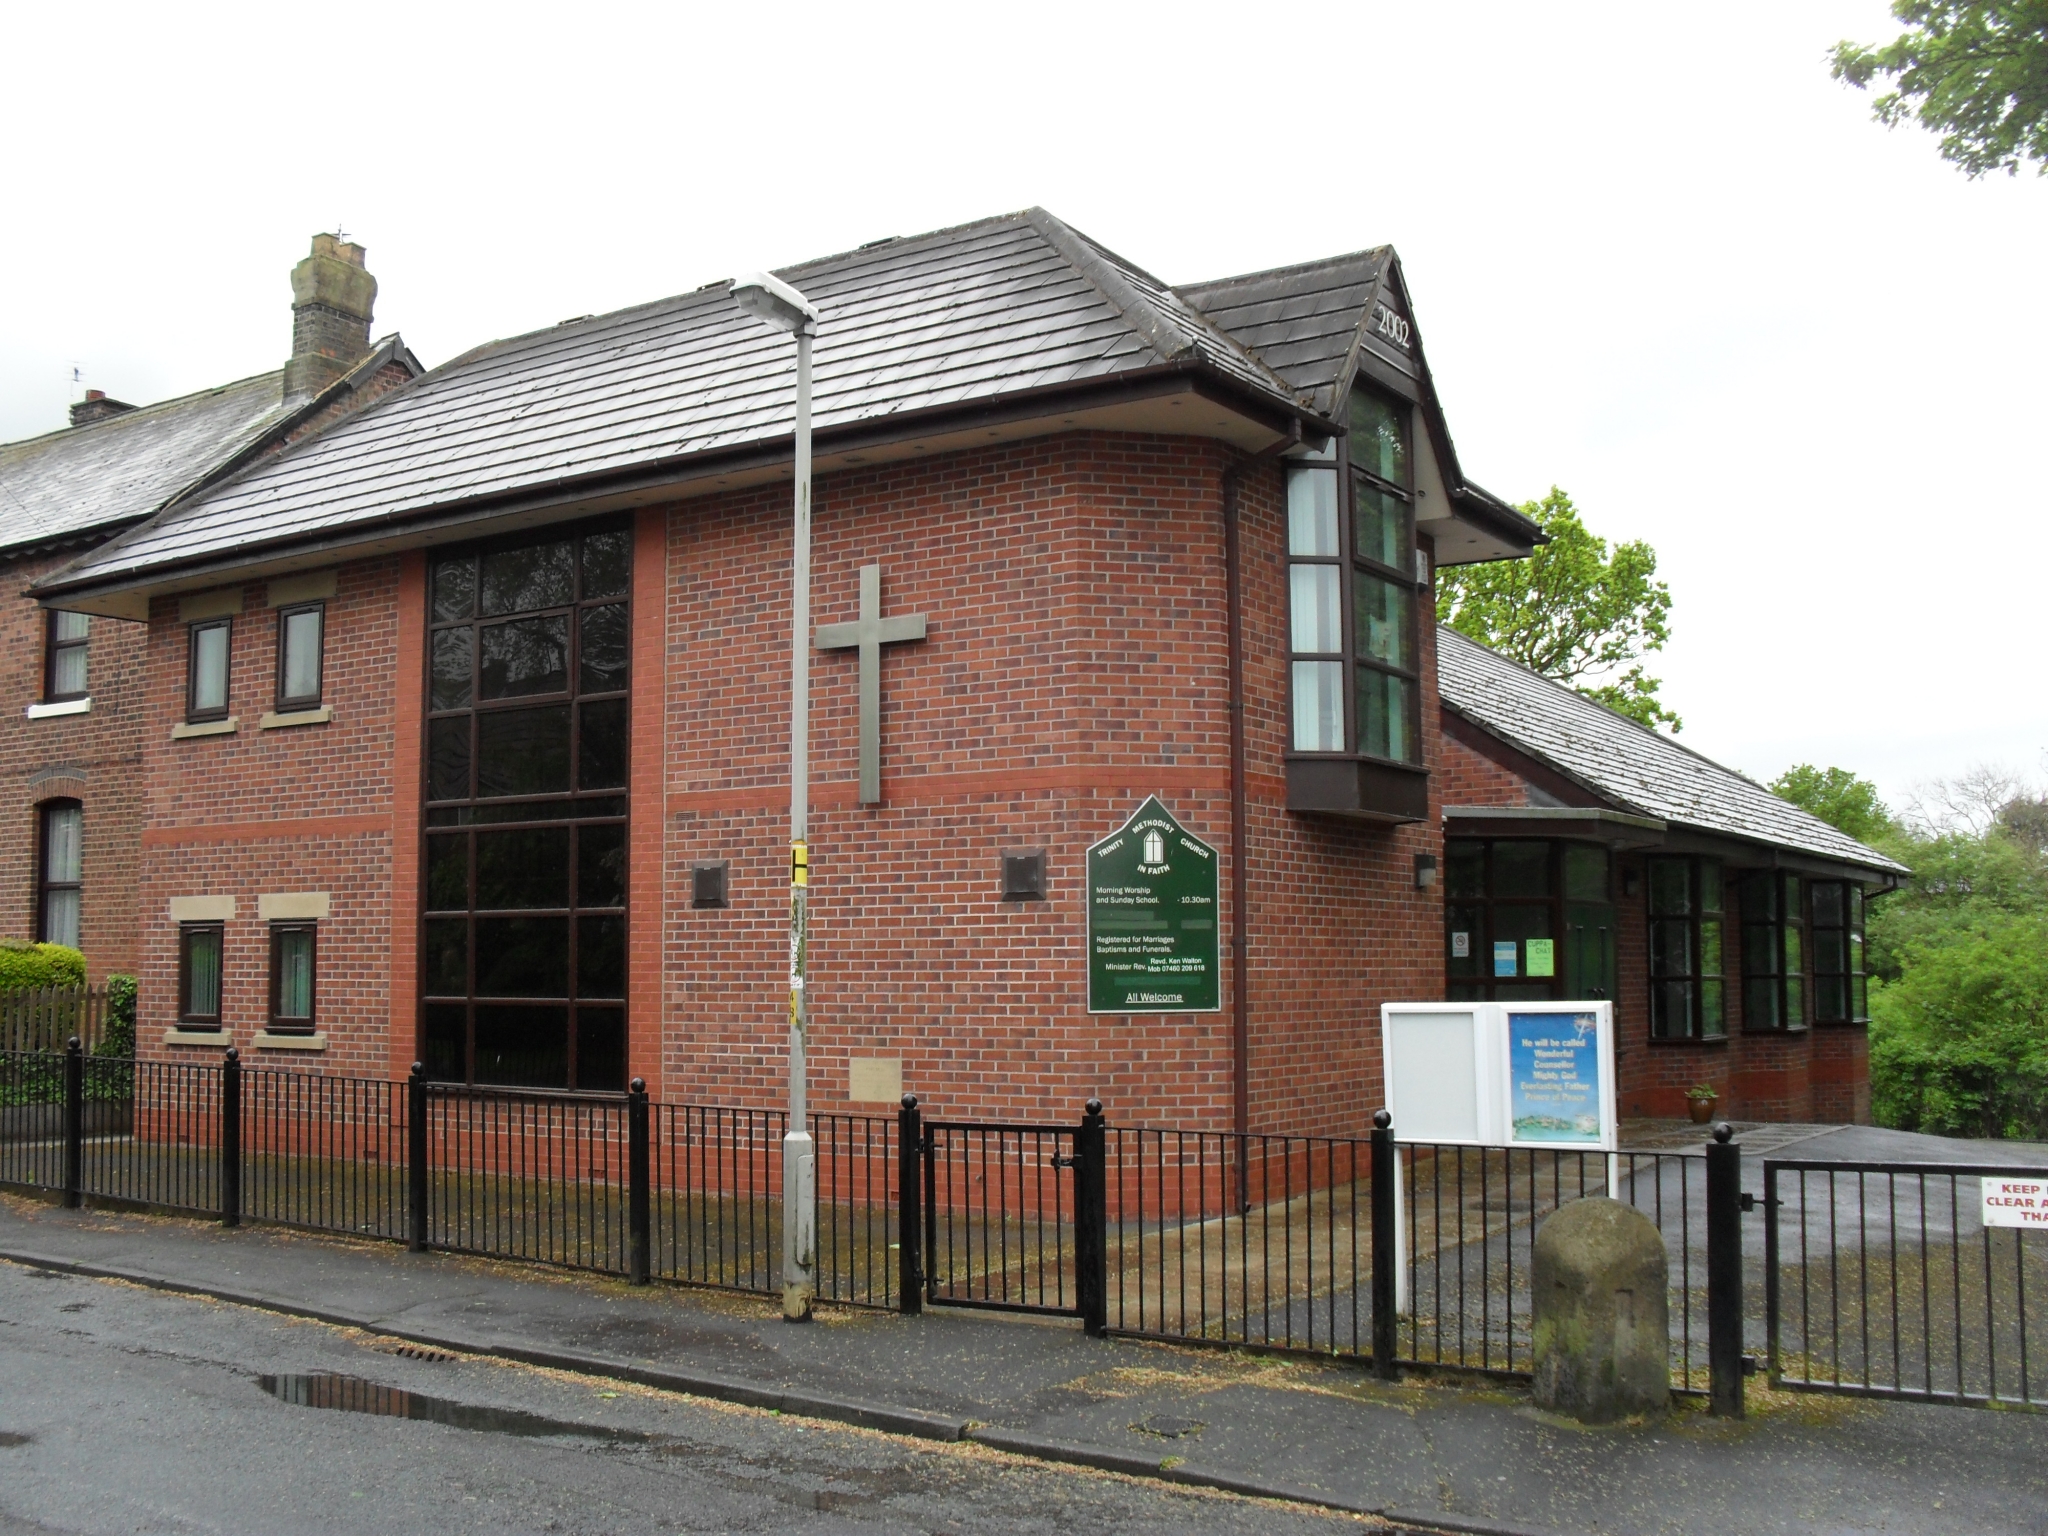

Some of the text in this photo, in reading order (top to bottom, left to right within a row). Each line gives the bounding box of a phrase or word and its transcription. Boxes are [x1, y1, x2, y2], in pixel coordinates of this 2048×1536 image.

[1379, 306, 1409, 348] 2002
[1131, 819, 1175, 834] METHODIST
[1097, 837, 1209, 859] TRINITY CHURCH
[1136, 864, 1171, 875] IN FAITH
[1096, 886, 1151, 895] Morning Worship
[1096, 896, 1109, 904] and
[1110, 896, 1135, 905] Sunday
[1181, 896, 1211, 904] 10.30am
[1096, 935, 1175, 944] Registered for Marriages
[1096, 946, 1127, 954] Baptisms
[1126, 992, 1183, 1002] All Welcome
[1522, 1038, 1586, 1047] He will be called
[1534, 1049, 1574, 1058] Wonderful
[1534, 1060, 1575, 1069] Counsellor
[1532, 1071, 1577, 1080] Mighty God
[1520, 1082, 1590, 1091] Everlasting Father
[1526, 1092, 1586, 1101] Prince of Peace
[2001, 1184, 2041, 1194] KEEP
[1986, 1197, 2035, 1207] CLEAR
[2021, 1212, 2048, 1221] THA
